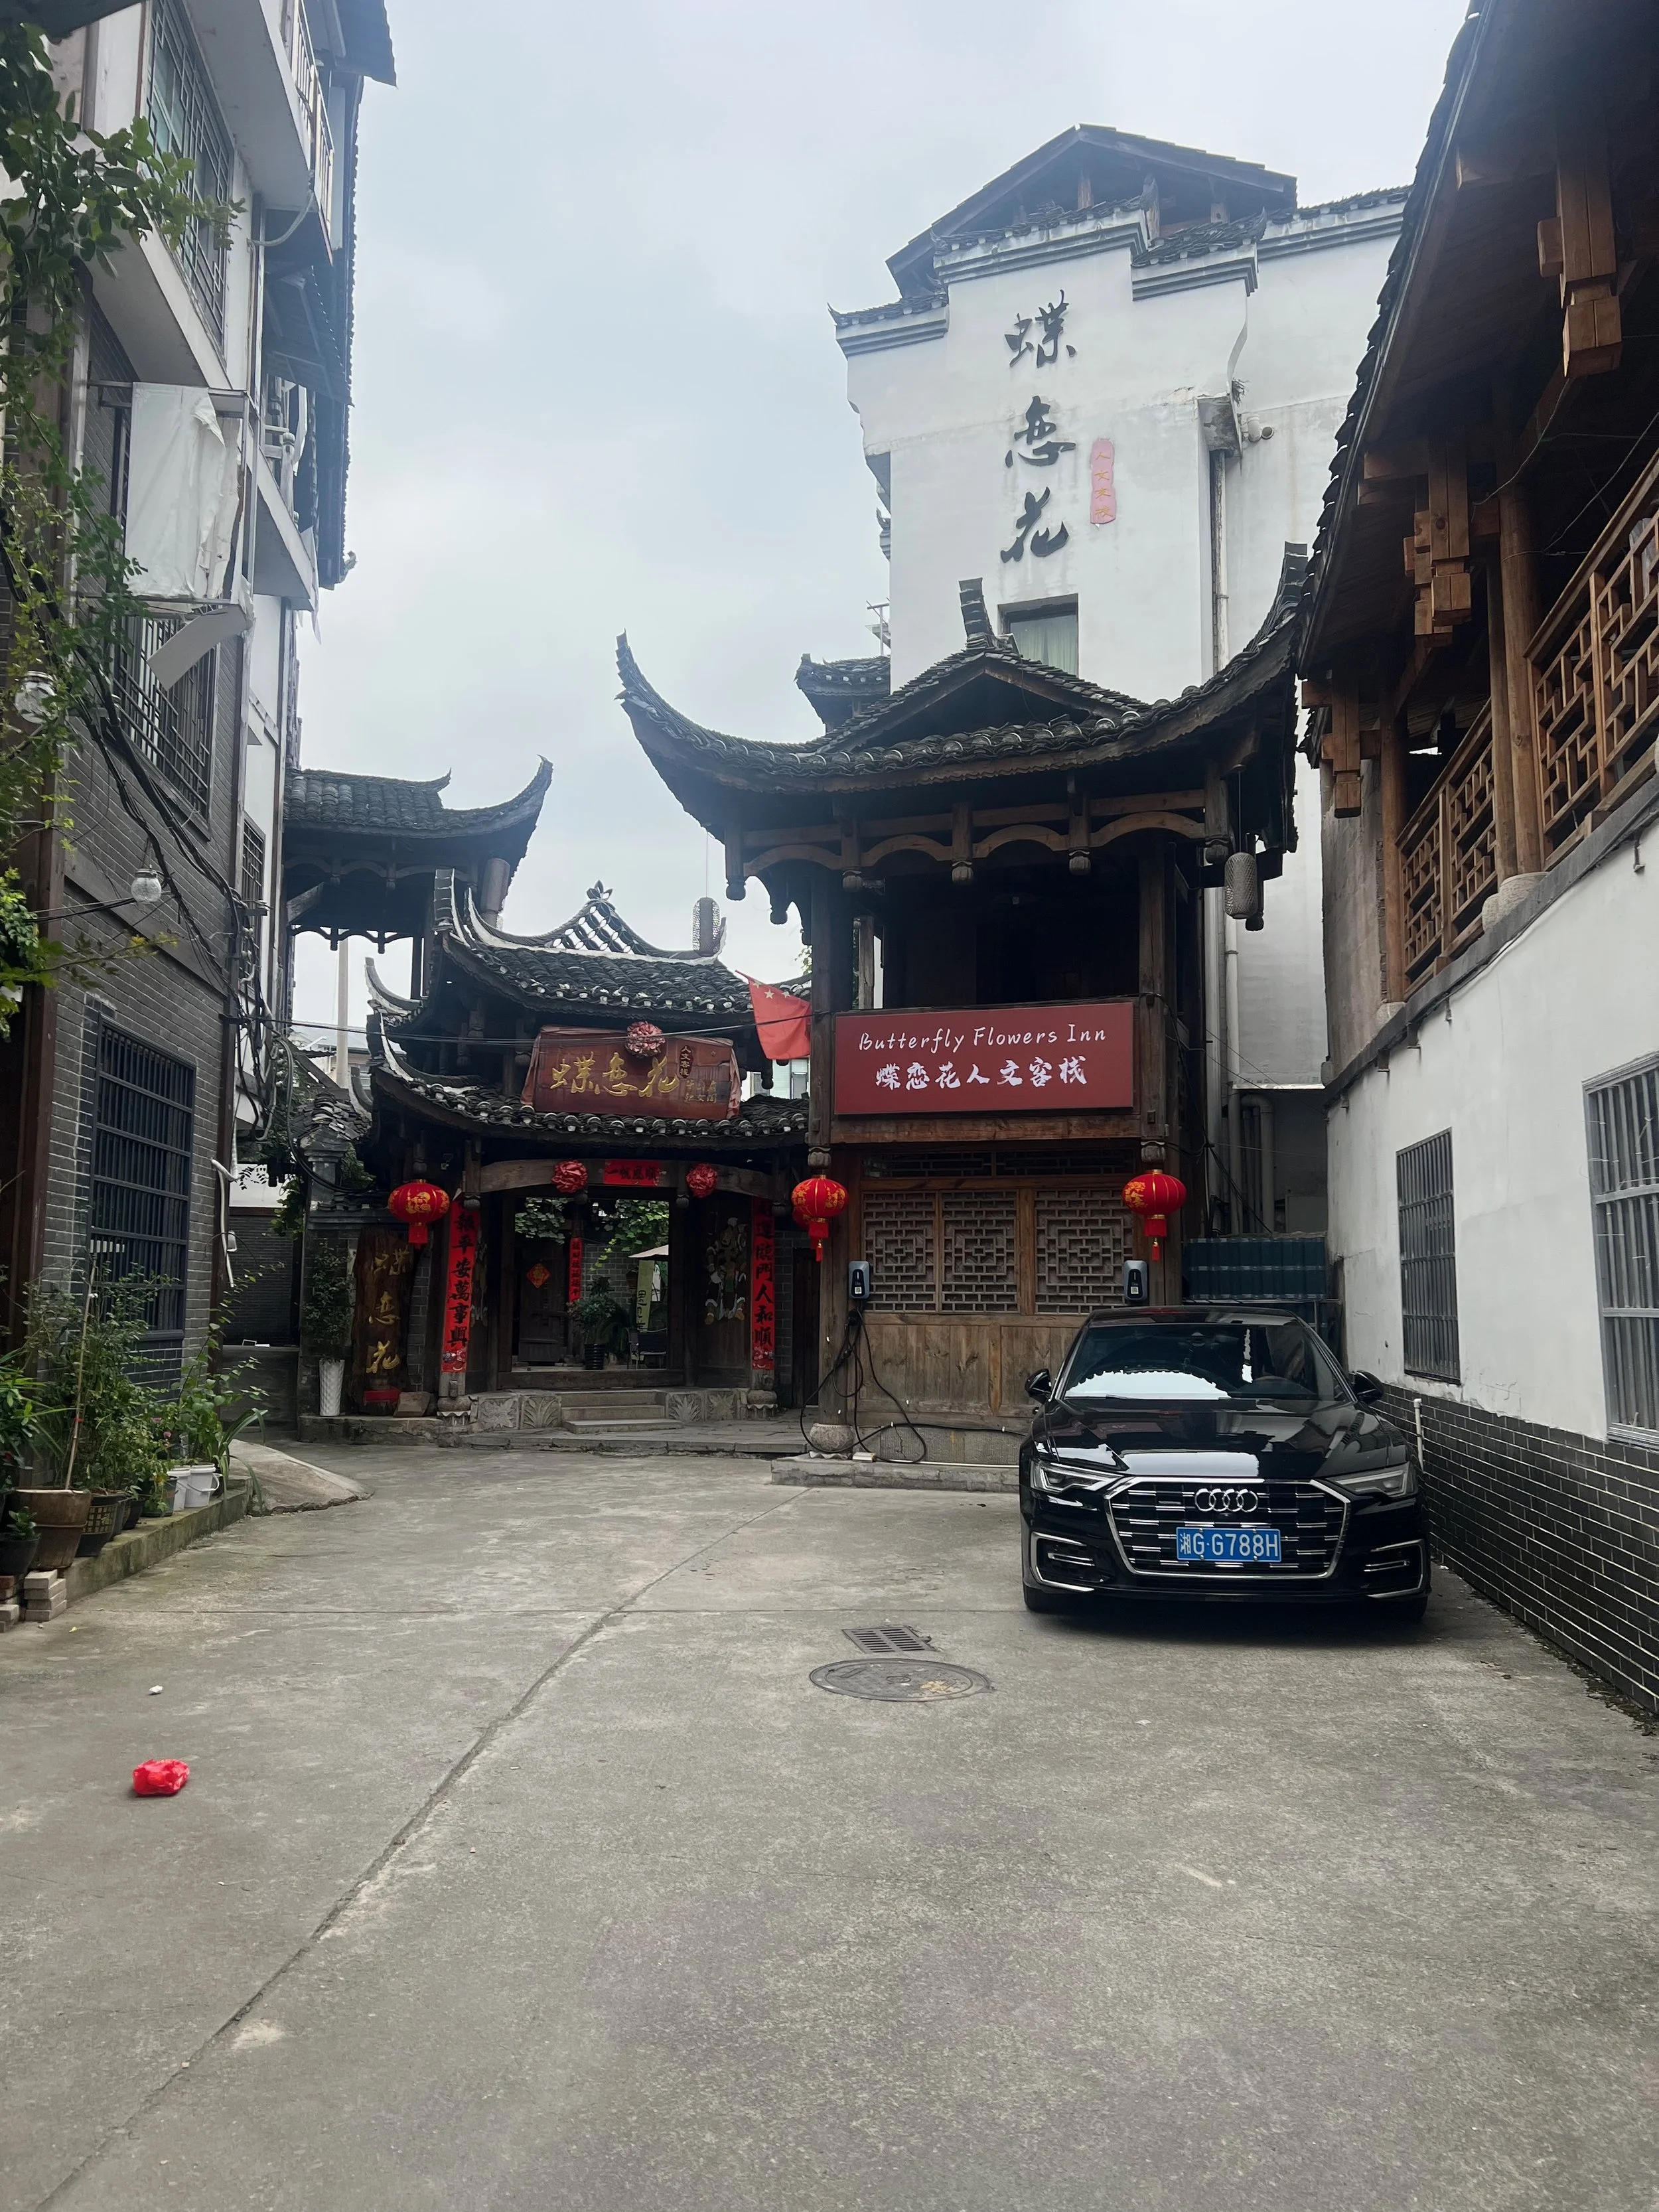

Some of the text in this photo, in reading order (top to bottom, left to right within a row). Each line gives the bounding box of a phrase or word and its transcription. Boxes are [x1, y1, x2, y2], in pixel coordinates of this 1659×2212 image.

[859, 1023, 1106, 1053] Butterfly Flowers Inn
[875, 1056, 1088, 1090] 蝶恋花人文客栈
